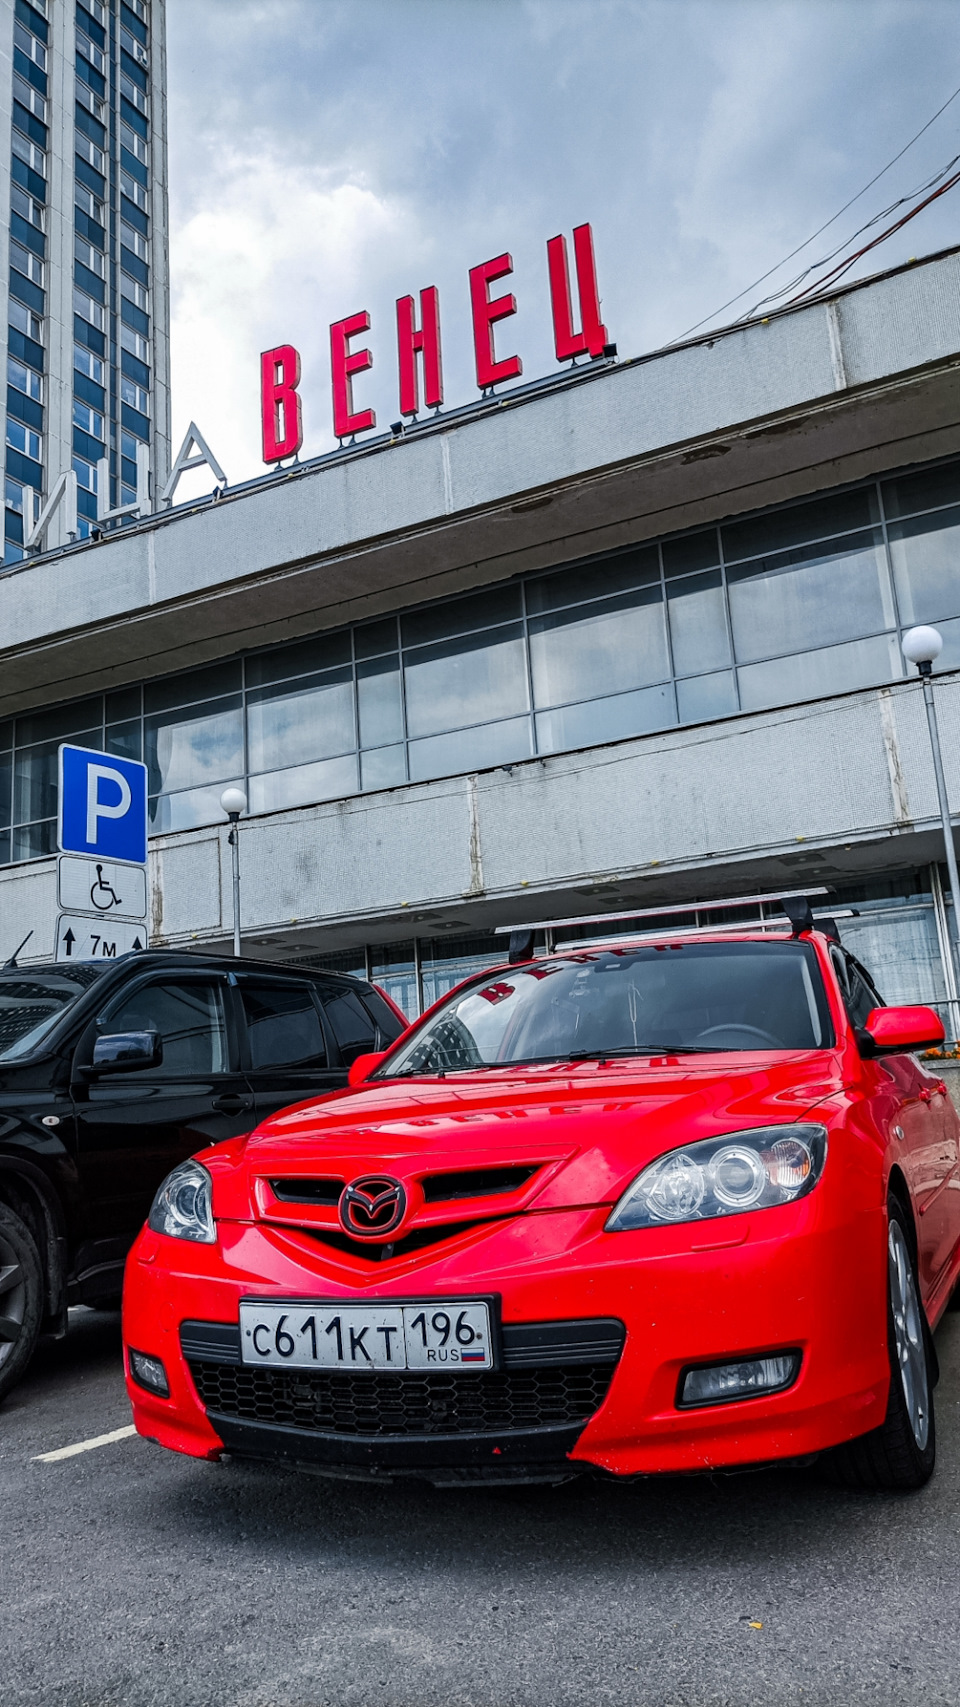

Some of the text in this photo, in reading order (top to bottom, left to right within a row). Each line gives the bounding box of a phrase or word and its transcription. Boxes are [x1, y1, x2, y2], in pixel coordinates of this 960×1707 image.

[0, 222, 608, 561] ИЦА ВЕНЕЦ
[86, 762, 132, 845] P
[252, 1310, 476, 1362] С611КТ 196
[427, 1348, 460, 1362] RUS
